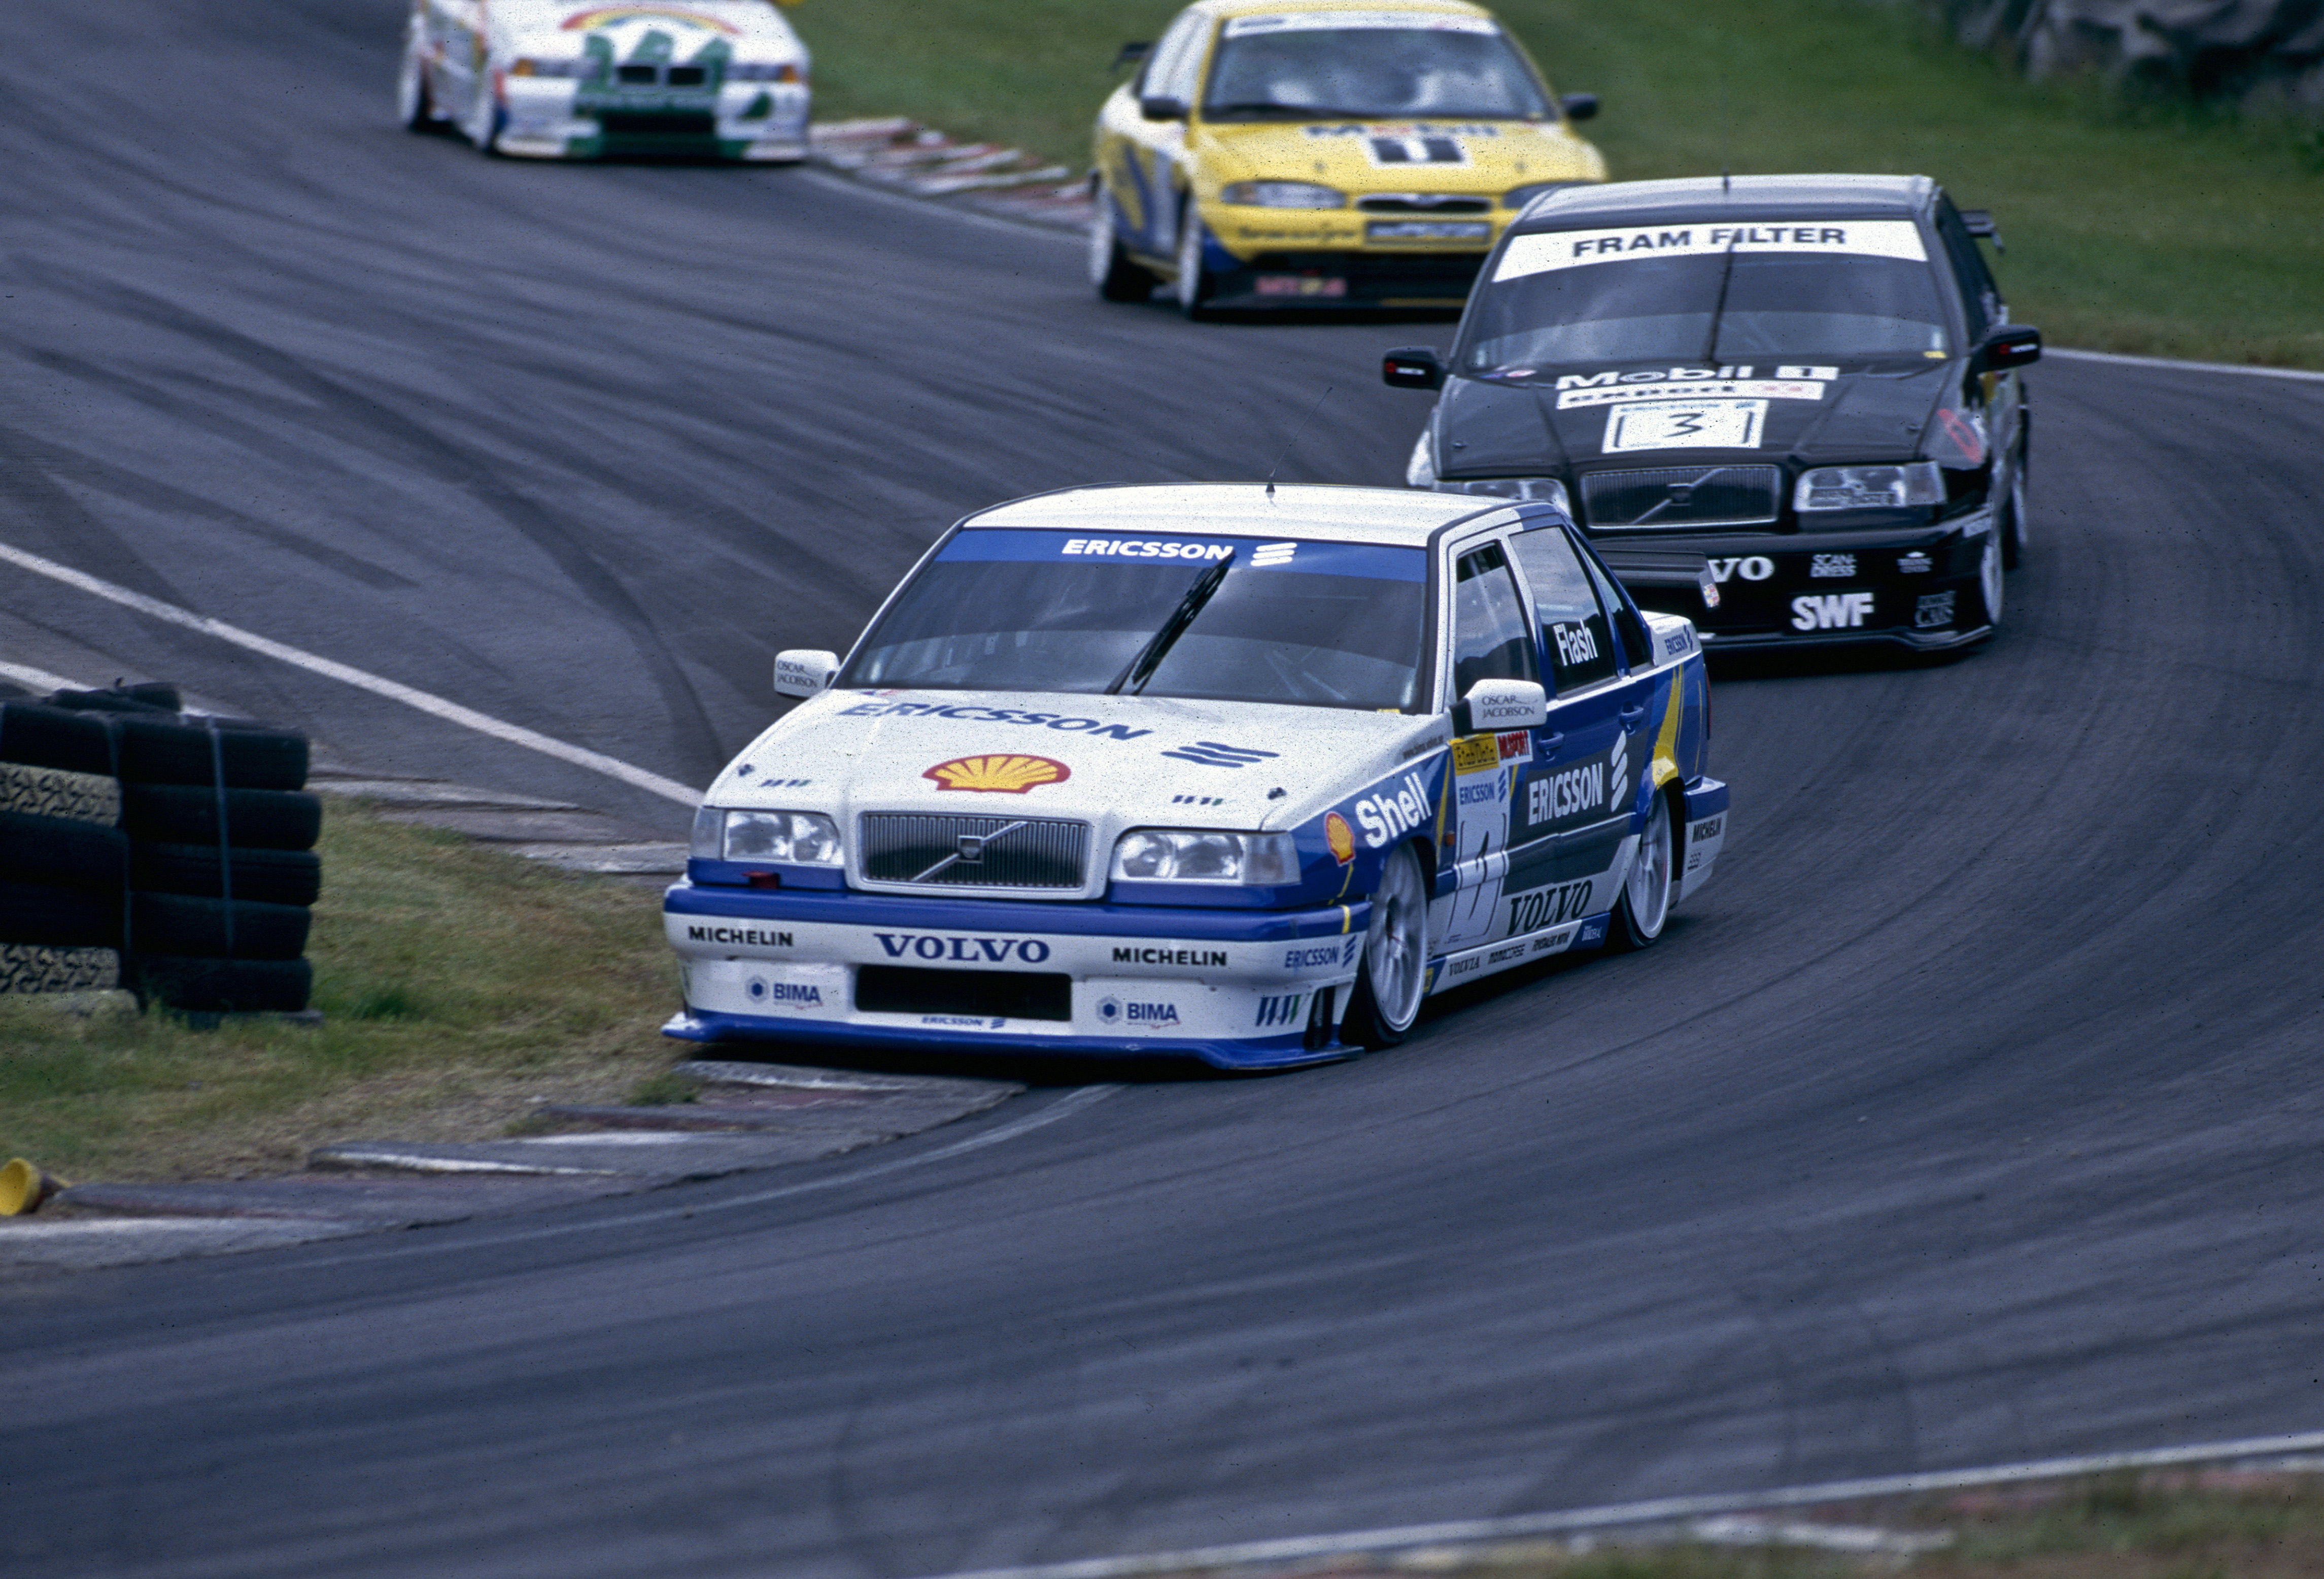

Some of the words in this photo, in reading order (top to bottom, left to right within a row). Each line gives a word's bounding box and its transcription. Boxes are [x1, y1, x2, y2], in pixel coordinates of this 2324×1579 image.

[1574, 230, 1691, 257] FRAM
[1711, 228, 1845, 244] FILTER
[1555, 366, 1754, 390] Mobil
[1664, 413, 1703, 438] 3
[1062, 539, 1234, 560] ERICSSON
[1791, 592, 1875, 631] SWF
[1553, 618, 1598, 666] Flash
[1664, 633, 1687, 655] ERICSSON
[777, 660, 805, 674] OSCAR
[777, 674, 817, 688] JACOBSON
[1482, 694, 1517, 705] OSCAR
[835, 702, 1154, 741] ERICSSON
[1482, 706, 1535, 719] JACOBSON
[1459, 782, 1495, 805] ERICSSON
[1528, 762, 1603, 826] ERICSSON
[1356, 771, 1432, 848] Shell
[1507, 880, 1593, 936] VOLVO
[688, 926, 793, 947] MICHELIN
[873, 933, 1050, 963] VOLVO
[1113, 947, 1227, 966] MICHELIN
[1285, 946, 1340, 968] ERICSSON
[773, 983, 822, 1003] BIMA
[921, 1016, 983, 1026] ERICSSON
[1126, 1003, 1178, 1021] BIMA
